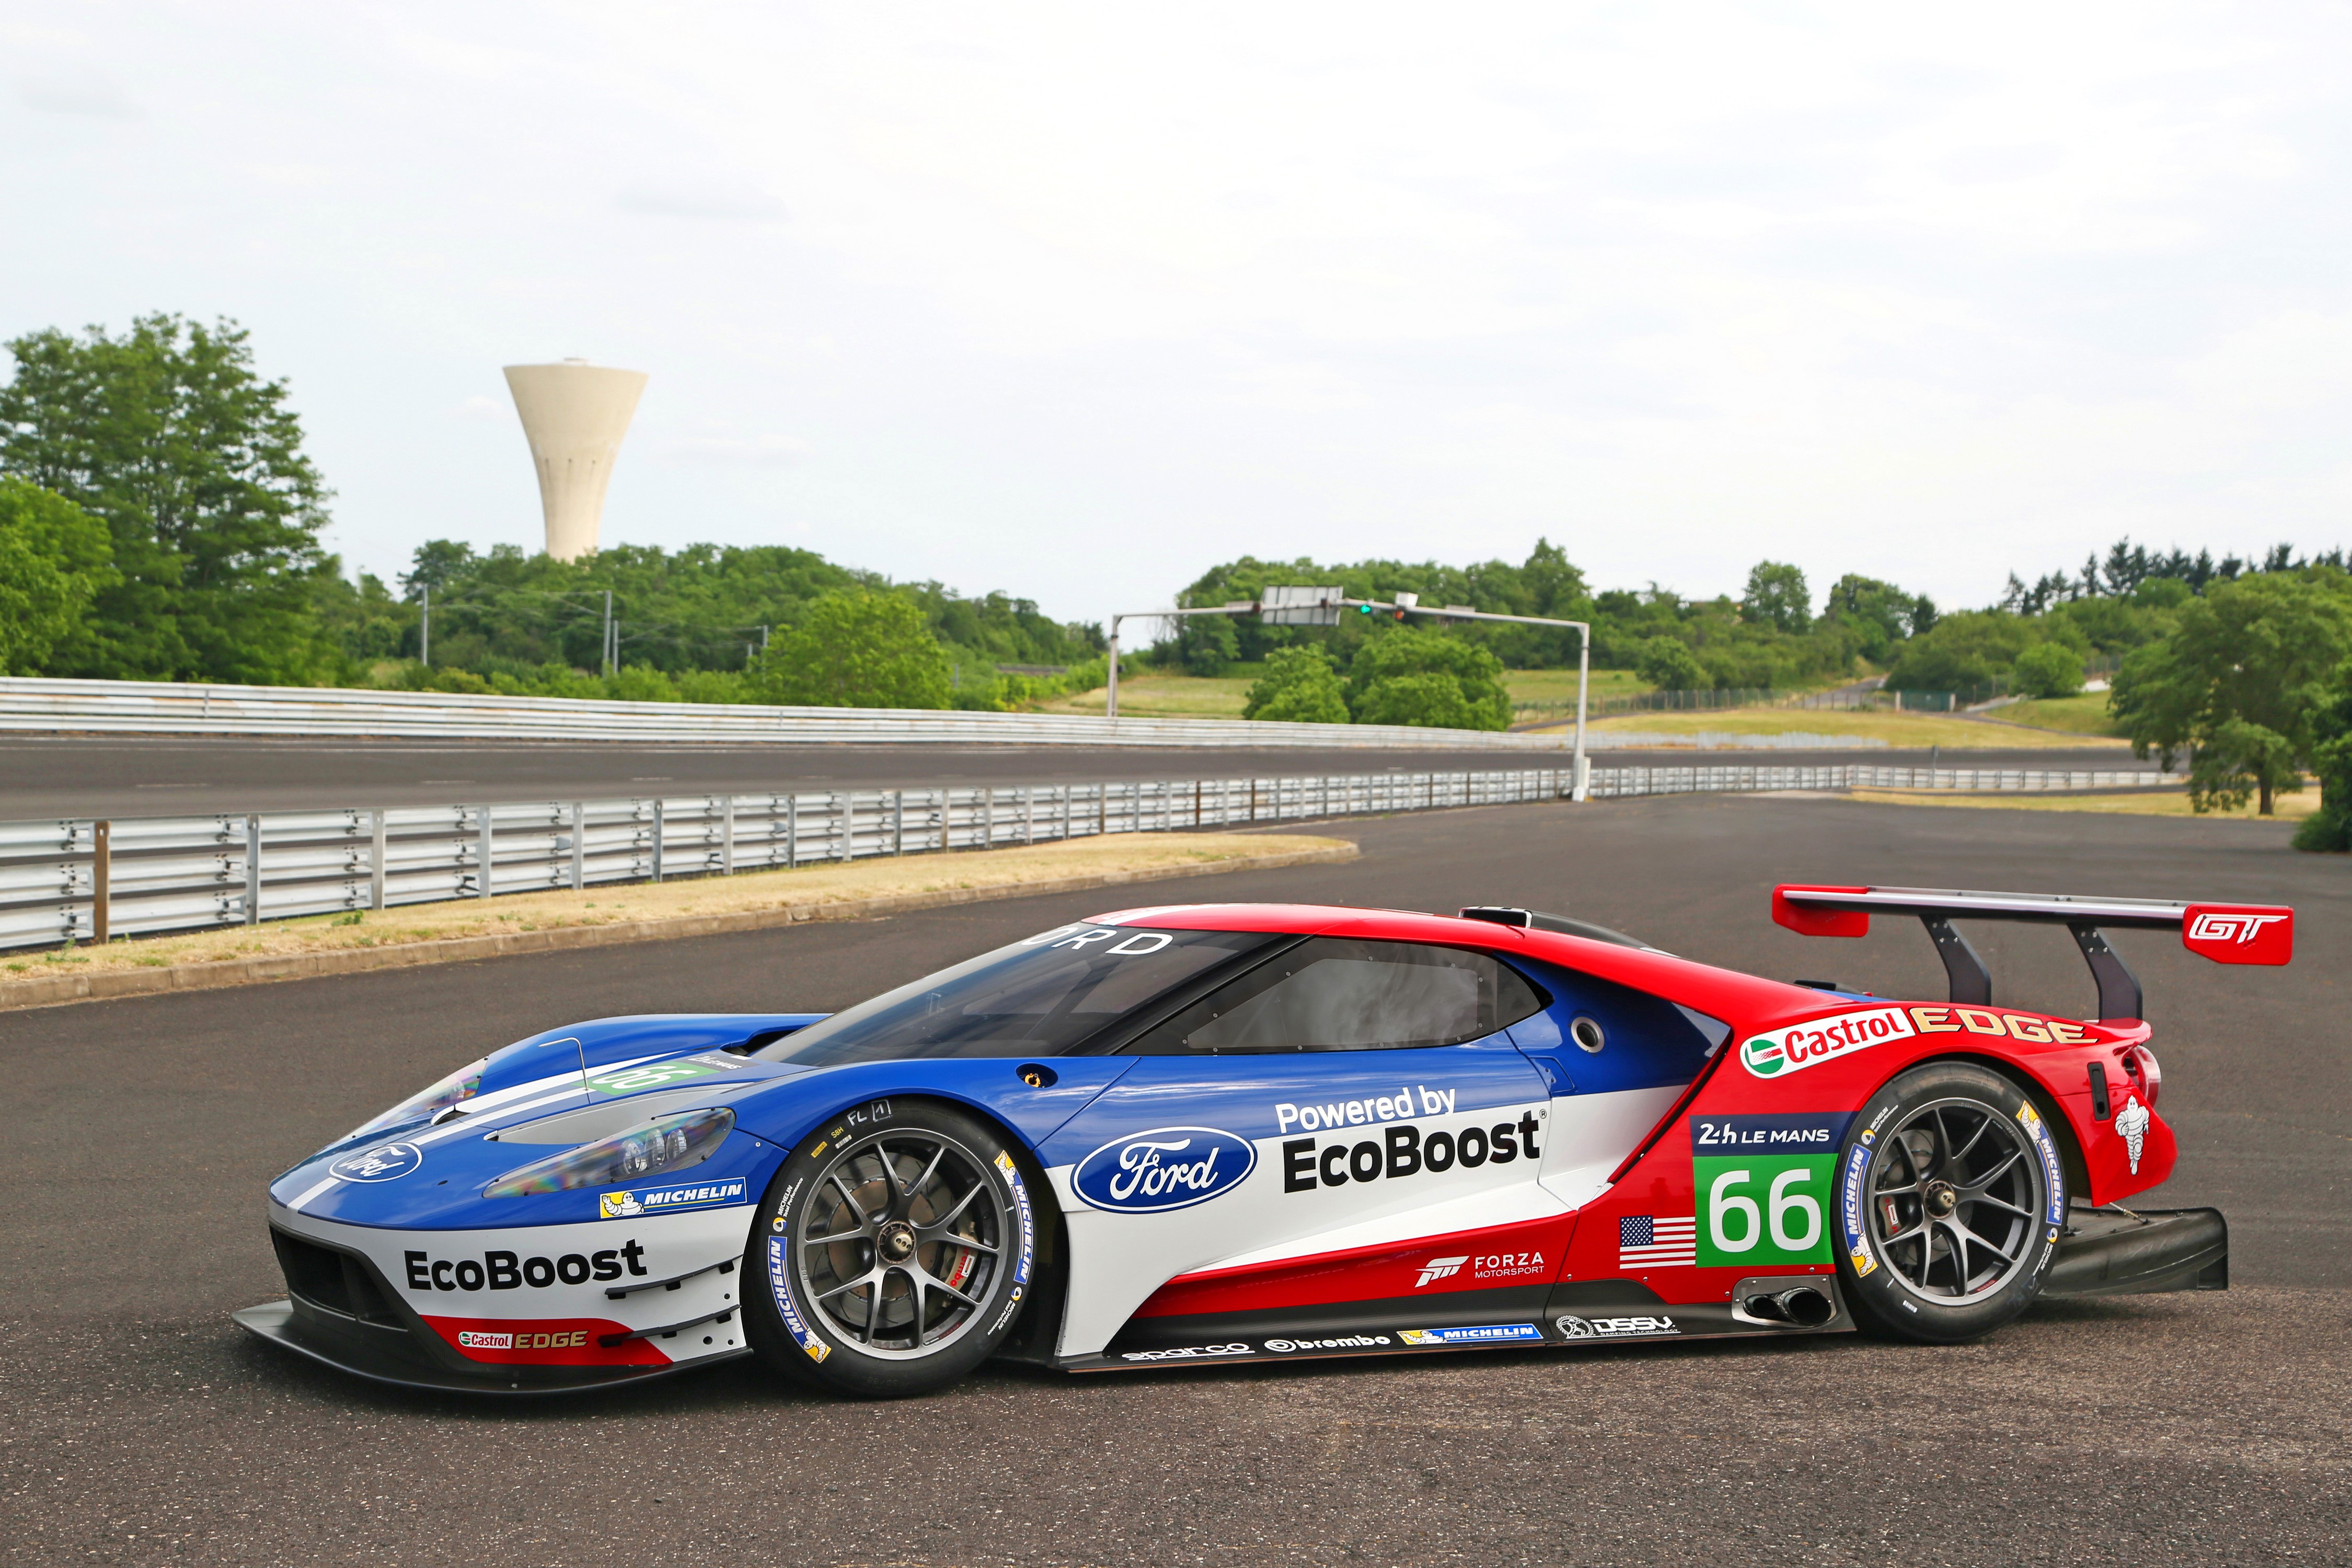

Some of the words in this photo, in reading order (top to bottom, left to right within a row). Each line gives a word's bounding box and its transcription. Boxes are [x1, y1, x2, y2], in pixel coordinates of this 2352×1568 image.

[1021, 927, 1173, 955] ORD
[2189, 913, 2289, 944] GT
[1784, 1011, 1905, 1064] Castrol
[1909, 1007, 2099, 1044] EDGE
[847, 1111, 867, 1126] FL
[1275, 1086, 1416, 1134] Powered
[1418, 1085, 1456, 1120] by
[1698, 1123, 1737, 1144] 24h
[1741, 1131, 1766, 1144] LE
[1770, 1129, 1829, 1143] MANS
[338, 1146, 407, 1177] Ford
[1110, 1138, 1220, 1200] Ford
[644, 1183, 743, 1205] MICHELIN
[1846, 1148, 1864, 1235] MICHELIN
[2041, 1138, 2061, 1221] MICHELIN
[778, 1185, 793, 1215] MICHELIN
[1709, 1168, 1822, 1253] 66
[1015, 1184, 1032, 1280] MICHELIN
[403, 1239, 647, 1291] EcoBoost
[1475, 1252, 1544, 1269] FORZA
[1475, 1266, 1544, 1278] MOTORSPORT
[771, 1240, 804, 1333] MICHELIN
[1444, 1327, 1534, 1339] MICHELIN
[1590, 1316, 1673, 1332] DSSV
[471, 1334, 509, 1346] Castrol
[515, 1331, 589, 1348] EDGE
[1122, 1343, 1250, 1360] sparco
[1294, 1335, 1391, 1349] brembo
